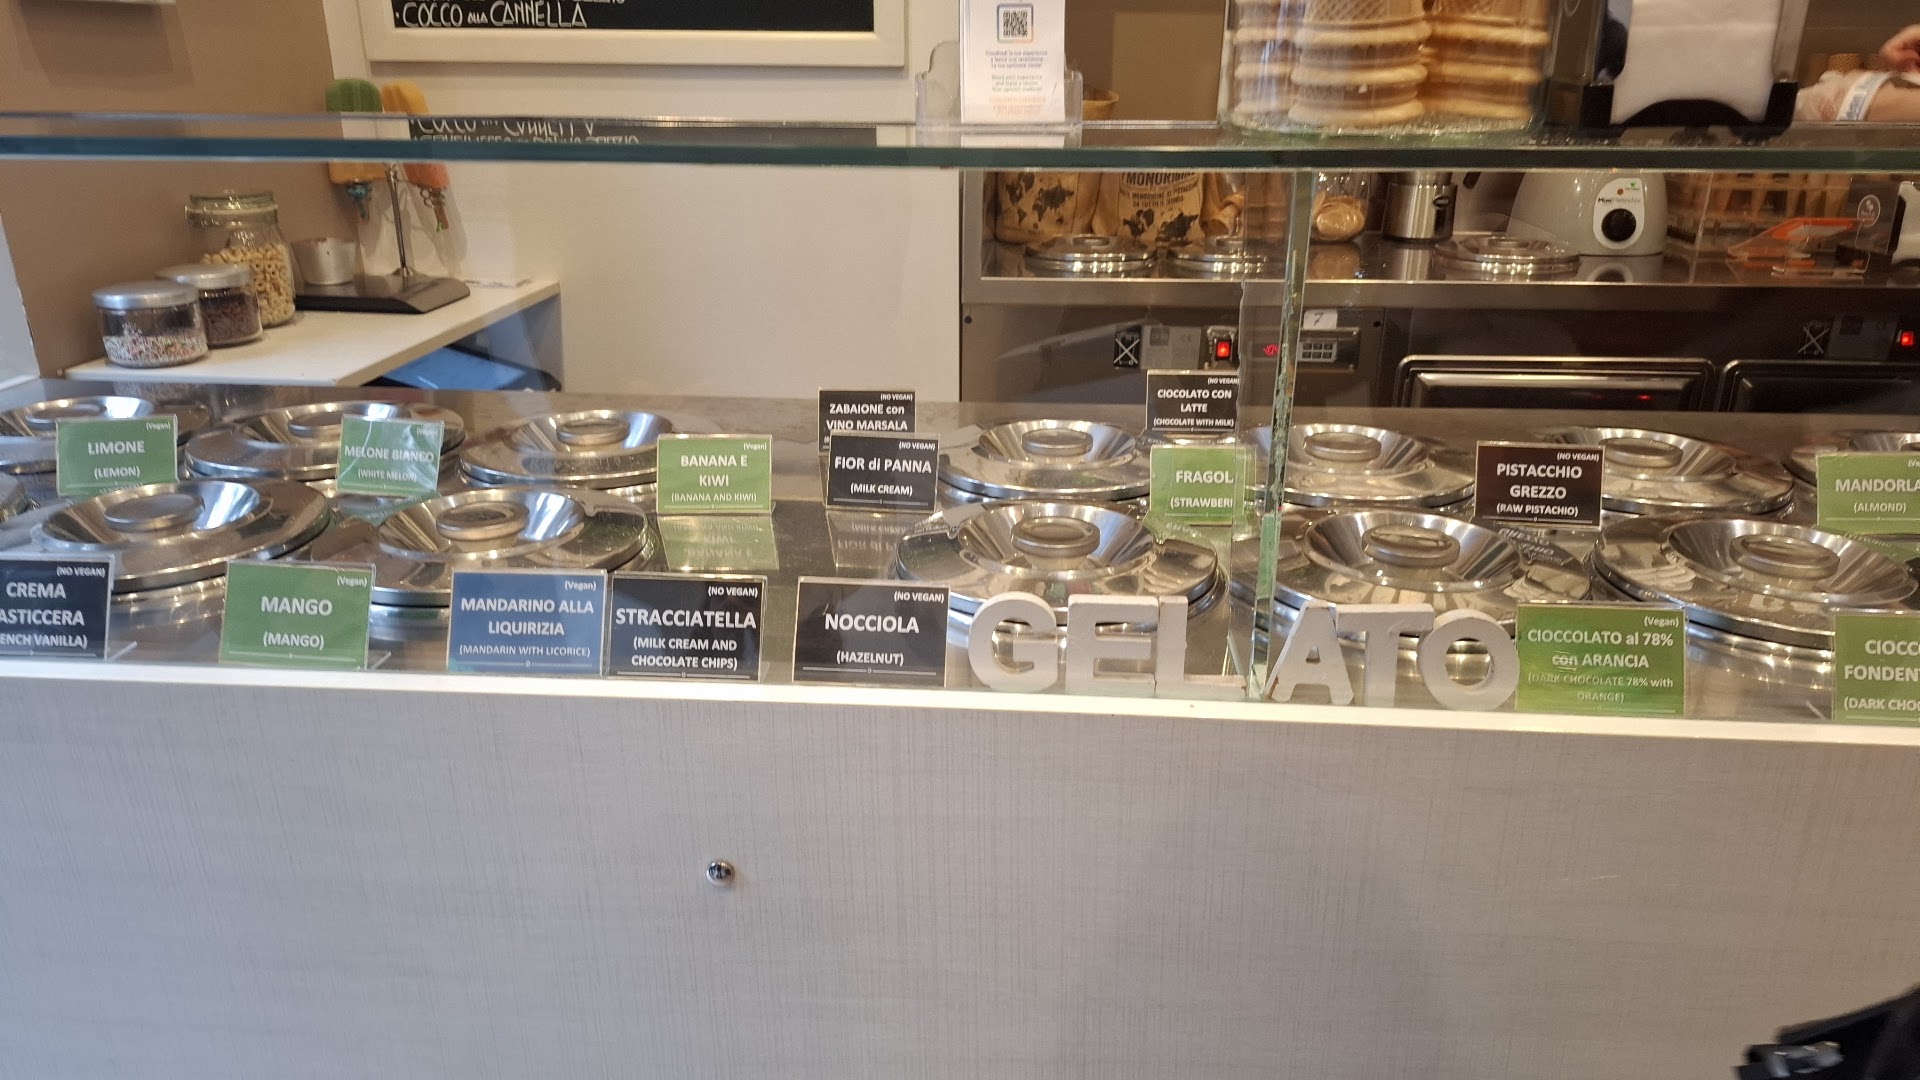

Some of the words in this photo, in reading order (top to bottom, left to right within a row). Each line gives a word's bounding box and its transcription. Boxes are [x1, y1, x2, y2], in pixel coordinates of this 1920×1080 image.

[403, 2, 463, 28] COCCO
[490, 1, 587, 28] CANNELLA
[1314, 312, 1324, 326] 7
[1207, 377, 1218, 386] (NO
[1219, 377, 1240, 386] VEGAN)
[880, 393, 892, 401] (NO
[892, 393, 913, 402] VEGAN)
[1157, 388, 1210, 399] CIOCOLATO
[1211, 389, 1232, 400] CON
[829, 403, 884, 415] ZABAIONE
[886, 405, 905, 415] con
[1180, 403, 1208, 413] LATTE
[146, 421, 171, 431] (Vegan)
[826, 419, 854, 431] VINO
[856, 420, 908, 431] MARSALA
[1153, 417, 1194, 426] (CHOCOLATE
[1196, 418, 1214, 426] WITH
[1215, 418, 1234, 427] MILK)
[88, 440, 146, 455] LIMONE
[744, 442, 767, 451] (Vegan)
[899, 441, 911, 450] (NO
[912, 442, 936, 452] VEGAN)
[344, 444, 390, 460] MELONE
[392, 449, 434, 464] BIANCO
[680, 454, 737, 468] BANANA
[740, 455, 748, 467] E
[1557, 452, 1571, 461] (NO
[1572, 452, 1600, 462] VEGAN)
[834, 456, 865, 471] FIOR
[868, 457, 880, 471] di
[884, 458, 932, 474] PANNA
[1496, 463, 1583, 479] PISTACCHIO
[94, 466, 140, 480] (LEMON)
[358, 468, 385, 479] (WHITE
[386, 470, 416, 483] MELON)
[1176, 470, 1234, 484] FRAGOL
[699, 474, 730, 487] KIWI
[850, 483, 877, 495] (MILK
[878, 484, 913, 497] CREAM)
[1510, 484, 1567, 500] GREZZO
[671, 492, 711, 504] (BANANA
[714, 493, 732, 502] AND
[734, 492, 757, 502] KIWI)
[1170, 496, 1233, 509] (STRAWBER
[1496, 503, 1523, 514] (RAW
[1525, 504, 1578, 518] PISTACHIO)
[1854, 502, 1906, 514] (ALMOND)
[56, 566, 73, 577] (NO
[74, 566, 106, 578] VEGAN)
[336, 575, 367, 588] (Vegan)
[564, 580, 596, 592] (Vegan)
[6, 582, 66, 600] CREMA
[708, 586, 725, 597] (NO
[726, 587, 758, 598] VEGAN)
[894, 590, 910, 602] (NO
[912, 592, 945, 604] VEGAN)
[260, 596, 333, 616] MANGO
[460, 597, 555, 612] MANDARINO
[558, 600, 594, 614] ALLA
[0, 608, 85, 626] ASTICCERA
[616, 608, 757, 629] STRACCIATELLA
[824, 613, 920, 634] NOCCIOLA
[1644, 616, 1680, 628] (Vegan)
[488, 620, 565, 636] LIQUIRIZIA
[0, 633, 32, 646] ENCH
[34, 633, 88, 650] VANILLA)
[263, 631, 324, 651] (MANGO)
[633, 636, 666, 650] (MILK
[668, 638, 709, 651] CREAM
[712, 640, 738, 651] AND
[1527, 628, 1622, 645] CIOCCOLATO
[1626, 632, 1638, 646] al
[1642, 632, 1674, 647] 78%
[460, 644, 516, 656] (MANDARIN
[518, 646, 544, 656] WITH
[546, 646, 591, 658] LICORICE)
[969, 592, 1520, 711] GELATO
[1865, 640, 1920, 656] CIOCC
[632, 654, 698, 668] CHOCOLATE
[701, 656, 738, 672] CHIPS)
[836, 650, 904, 666] (HAZELNUT)
[1582, 654, 1649, 668] ARANCIA
[1528, 672, 1560, 684] (DARK
[1563, 674, 1624, 686] CHOCOLATE
[1626, 677, 1648, 687] 78%
[1650, 678, 1674, 688] with
[1844, 664, 1920, 682] FONDEN
[1576, 691, 1624, 704] ORANGE)
[1844, 696, 1885, 710] (DARK
